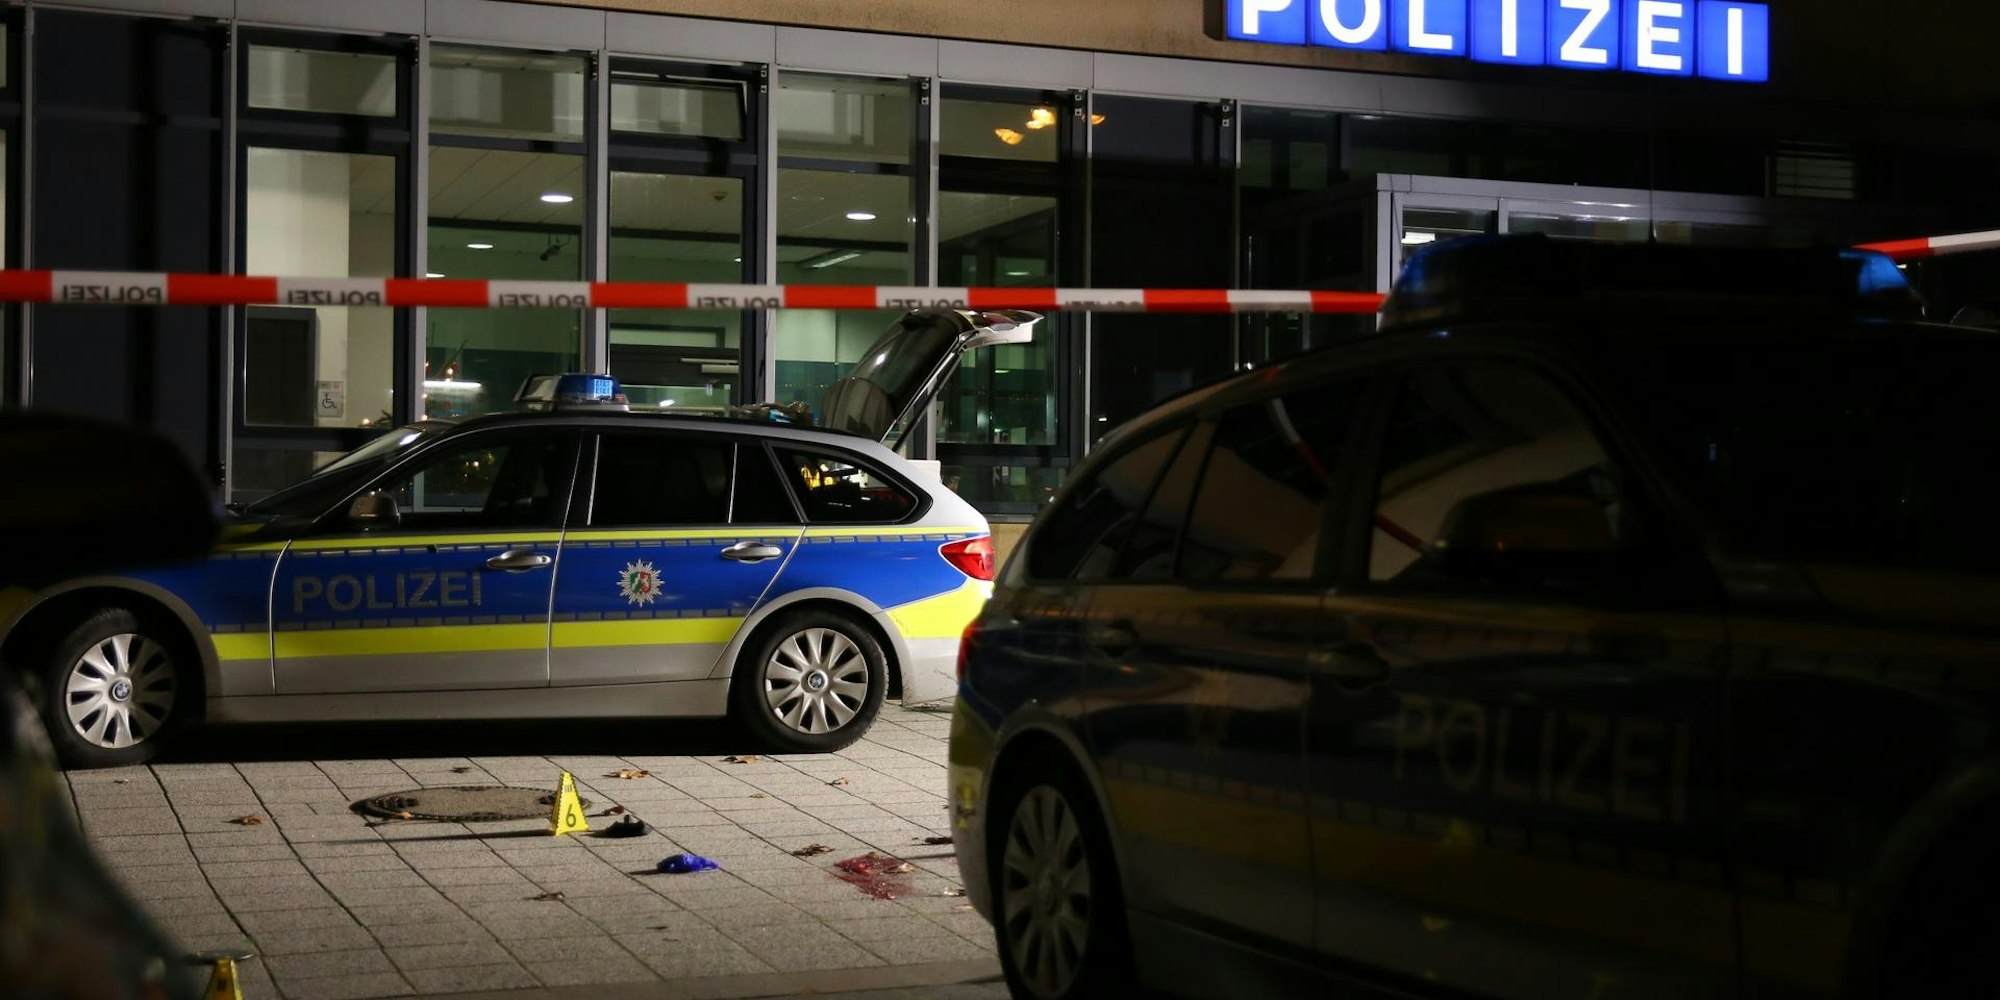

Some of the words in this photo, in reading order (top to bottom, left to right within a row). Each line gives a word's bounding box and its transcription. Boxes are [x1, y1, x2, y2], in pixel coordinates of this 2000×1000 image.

[292, 571, 482, 613] POLIZEI
[1394, 693, 1693, 826] POLIZEI
[566, 803, 577, 828] 6
